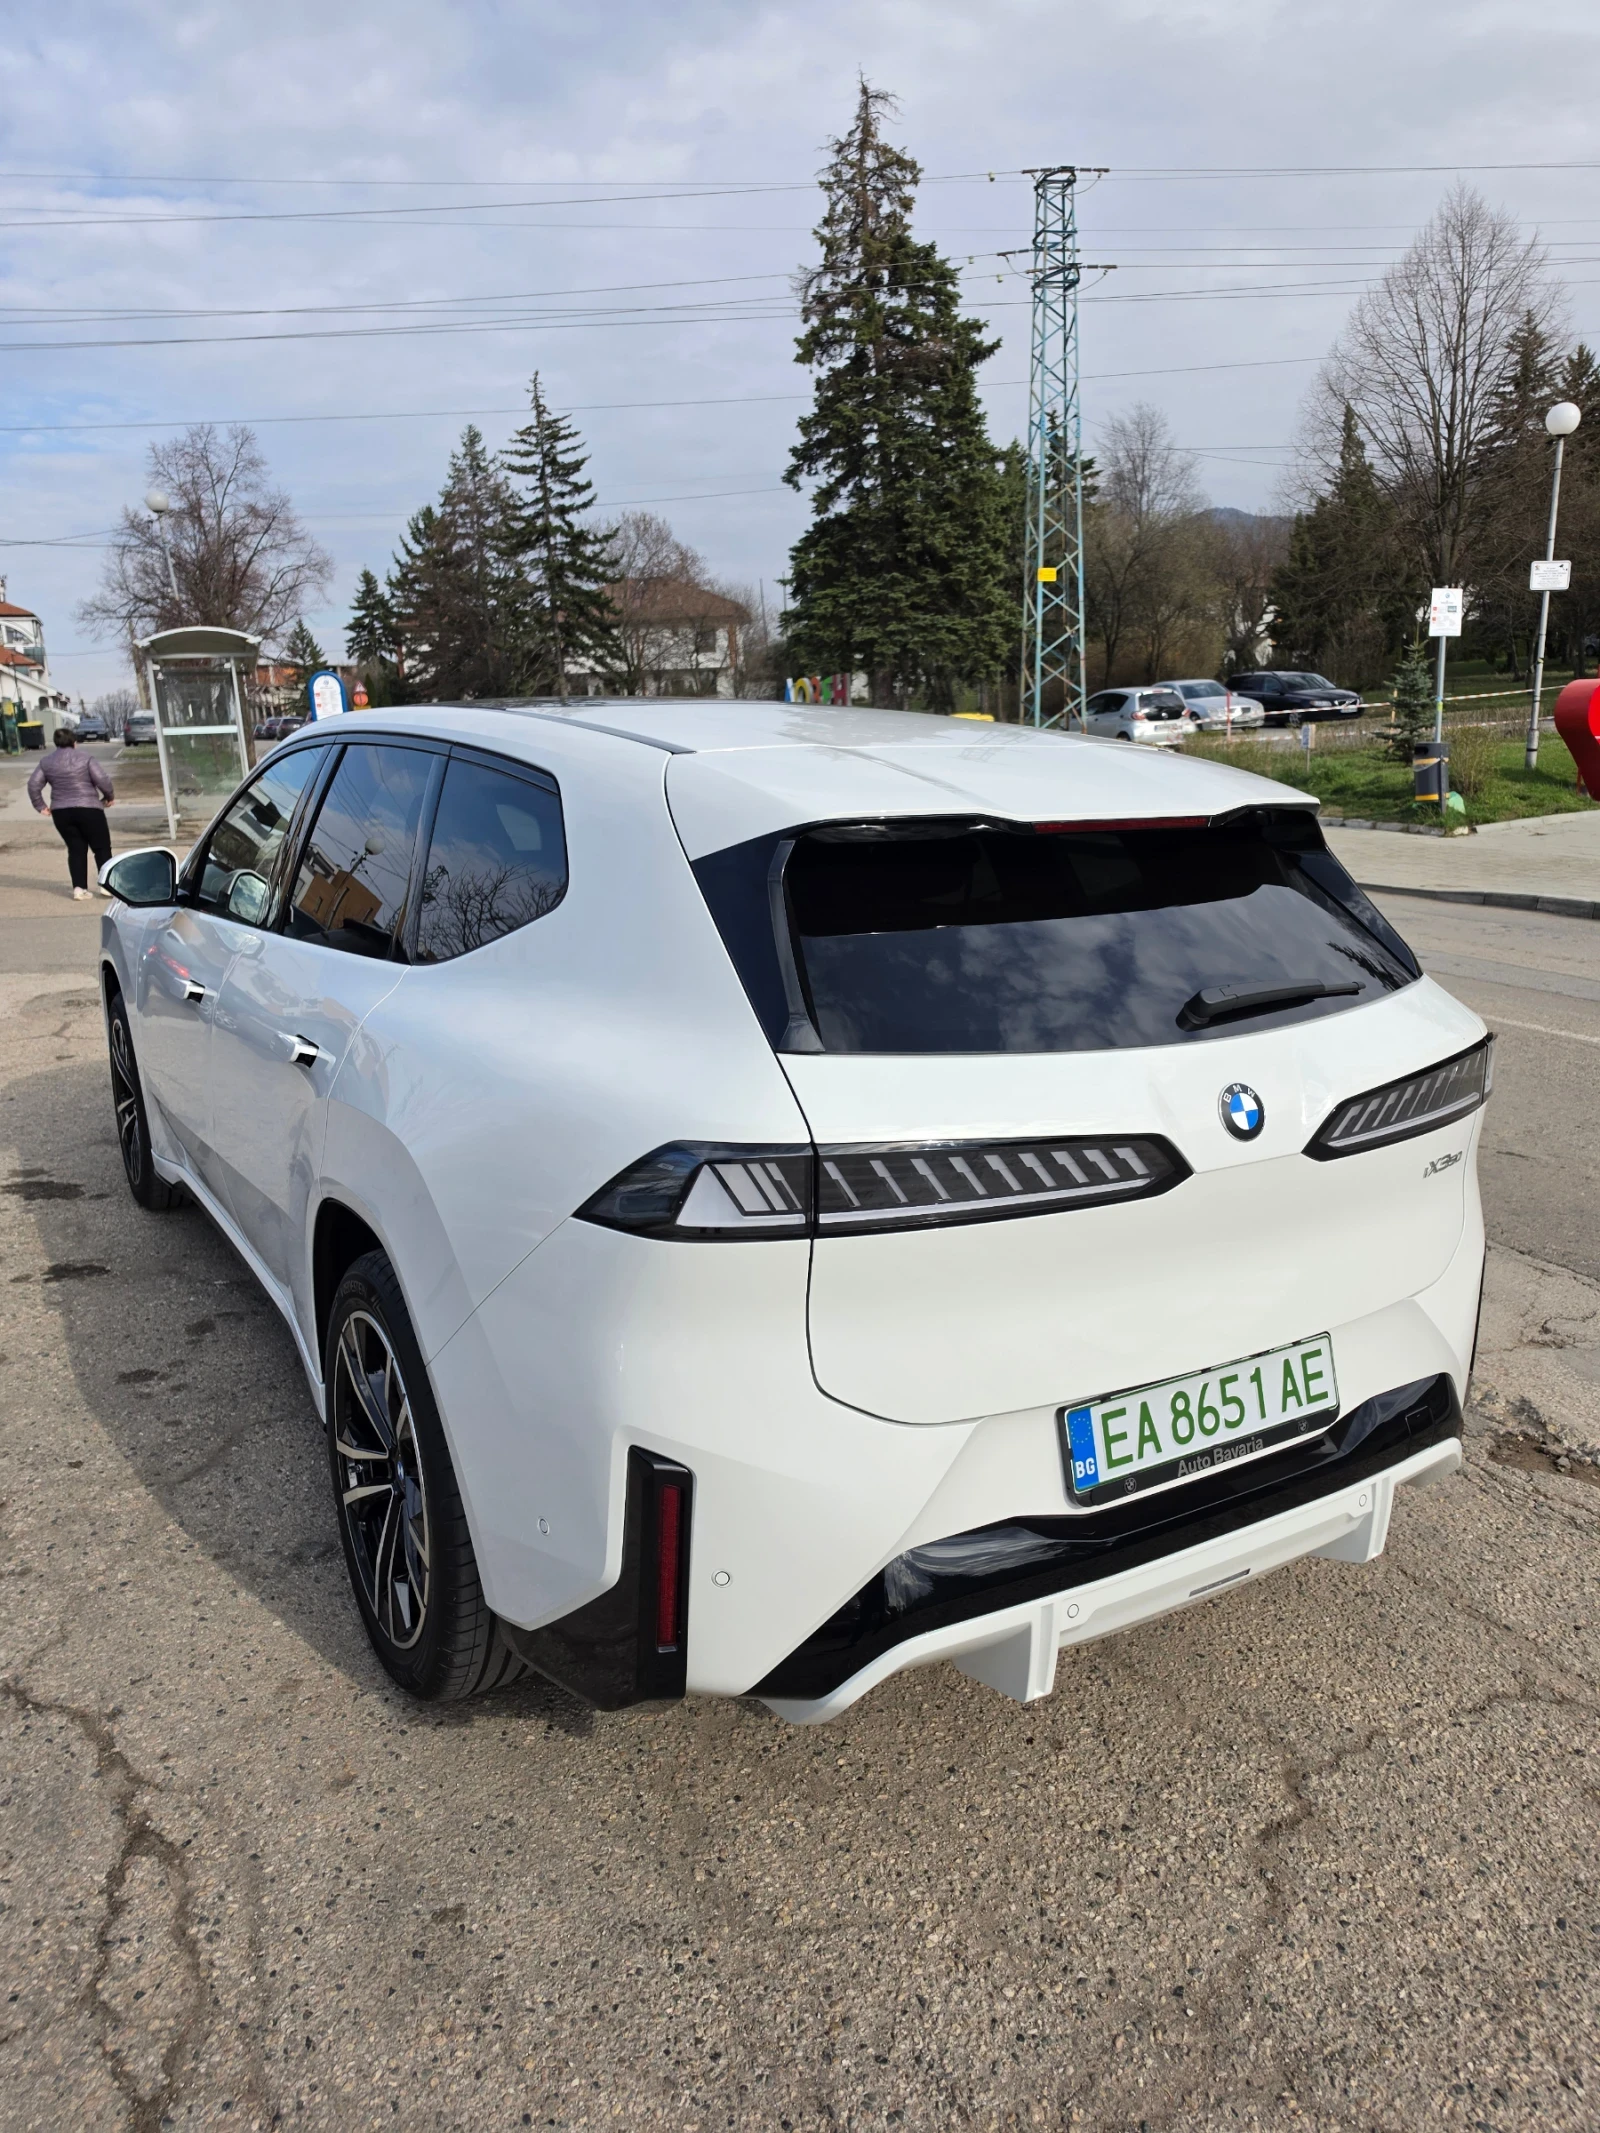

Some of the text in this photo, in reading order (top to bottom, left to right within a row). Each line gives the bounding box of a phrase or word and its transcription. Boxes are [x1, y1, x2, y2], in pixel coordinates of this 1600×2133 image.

[1223, 1084, 1256, 1103] BMW
[1100, 1348, 1330, 1470] EA 8651 AE
[1074, 1457, 1096, 1479] BG
[1177, 1437, 1264, 1478] Auto Bavaria
